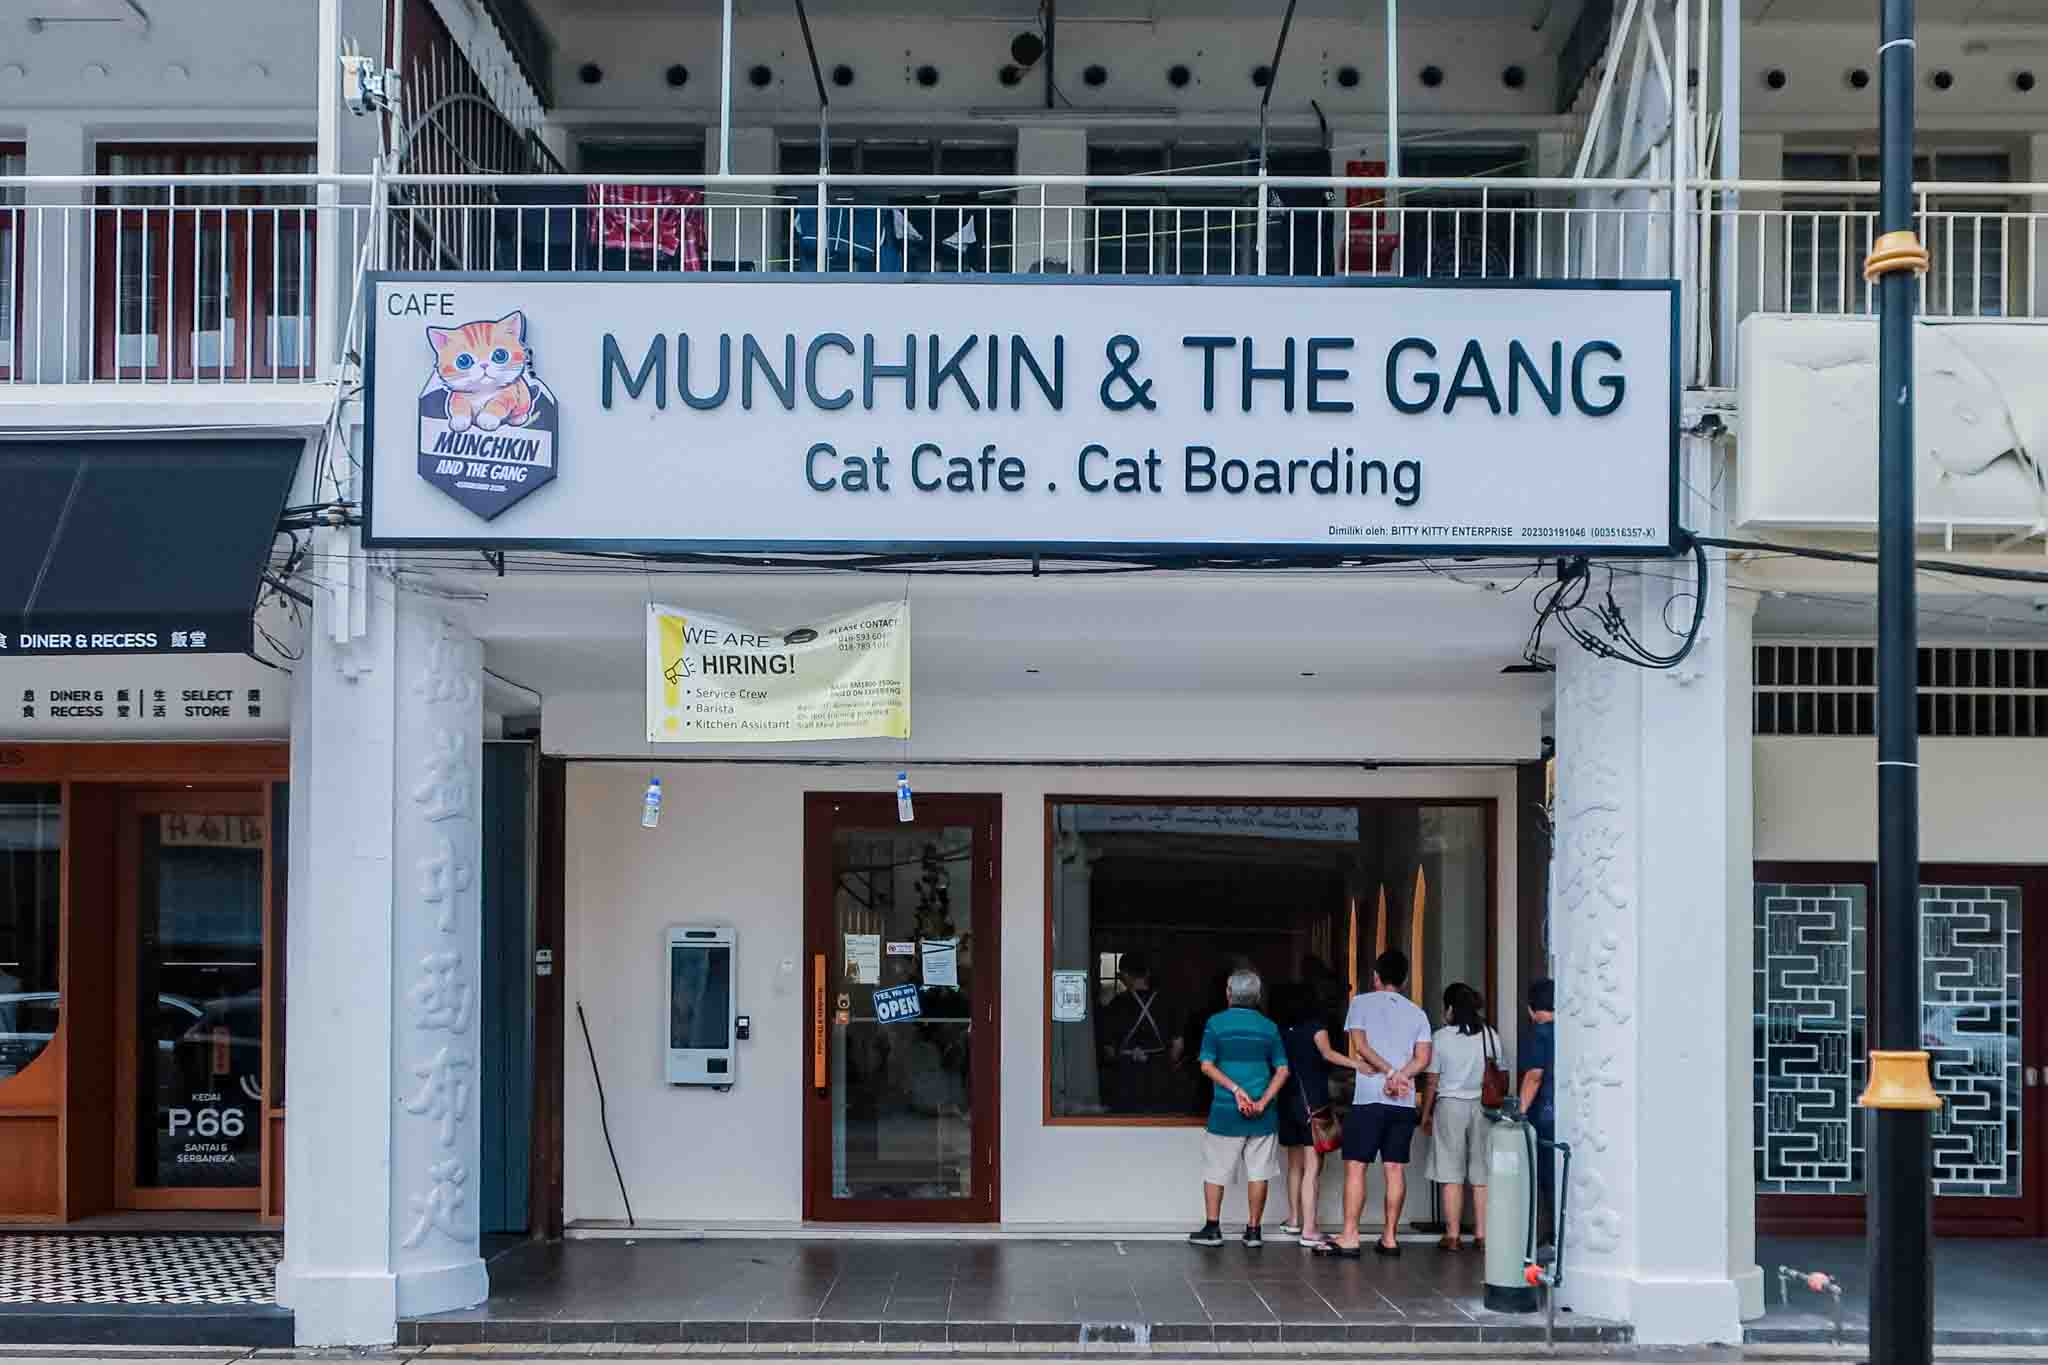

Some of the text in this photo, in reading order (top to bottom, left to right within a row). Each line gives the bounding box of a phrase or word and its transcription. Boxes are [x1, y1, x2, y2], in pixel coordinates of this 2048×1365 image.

[387, 293, 455, 316] CAFE
[601, 333, 1626, 417] MUNCHKIN & THE GANG
[432, 431, 541, 462] MUNCHKIN
[435, 459, 529, 483] AND THE GANG
[805, 442, 890, 493] Cat
[911, 442, 1026, 493] Cafe
[1077, 443, 1162, 493] Cat
[1184, 446, 1422, 507] Boarding
[1328, 525, 1363, 536] Dimiliki
[1365, 525, 1389, 536] oleh:
[1391, 526, 1418, 536] BITTY
[1421, 526, 1449, 536] KITTY
[1452, 526, 1513, 537] ENTERPRISE
[20, 634, 73, 648] DINER
[75, 634, 89, 648] &
[91, 633, 158, 648] RECESS
[682, 625, 769, 649] WE ARE
[702, 654, 795, 675] HIRING!
[50, 690, 104, 701] DINER &
[181, 690, 234, 701] SELECT
[695, 688, 768, 699] Service Crew
[50, 705, 104, 717] RECESS
[184, 705, 230, 717] STORE
[695, 703, 735, 713] Barista
[695, 719, 738, 729] Kitchen
[740, 719, 790, 729] Assistant
[878, 995, 918, 1020] OPEN
[191, 1093, 221, 1102] KEDAI
[167, 1107, 245, 1137] P.66
[184, 1143, 219, 1152] SANTAI
[176, 1153, 236, 1163] SERBANEKA
